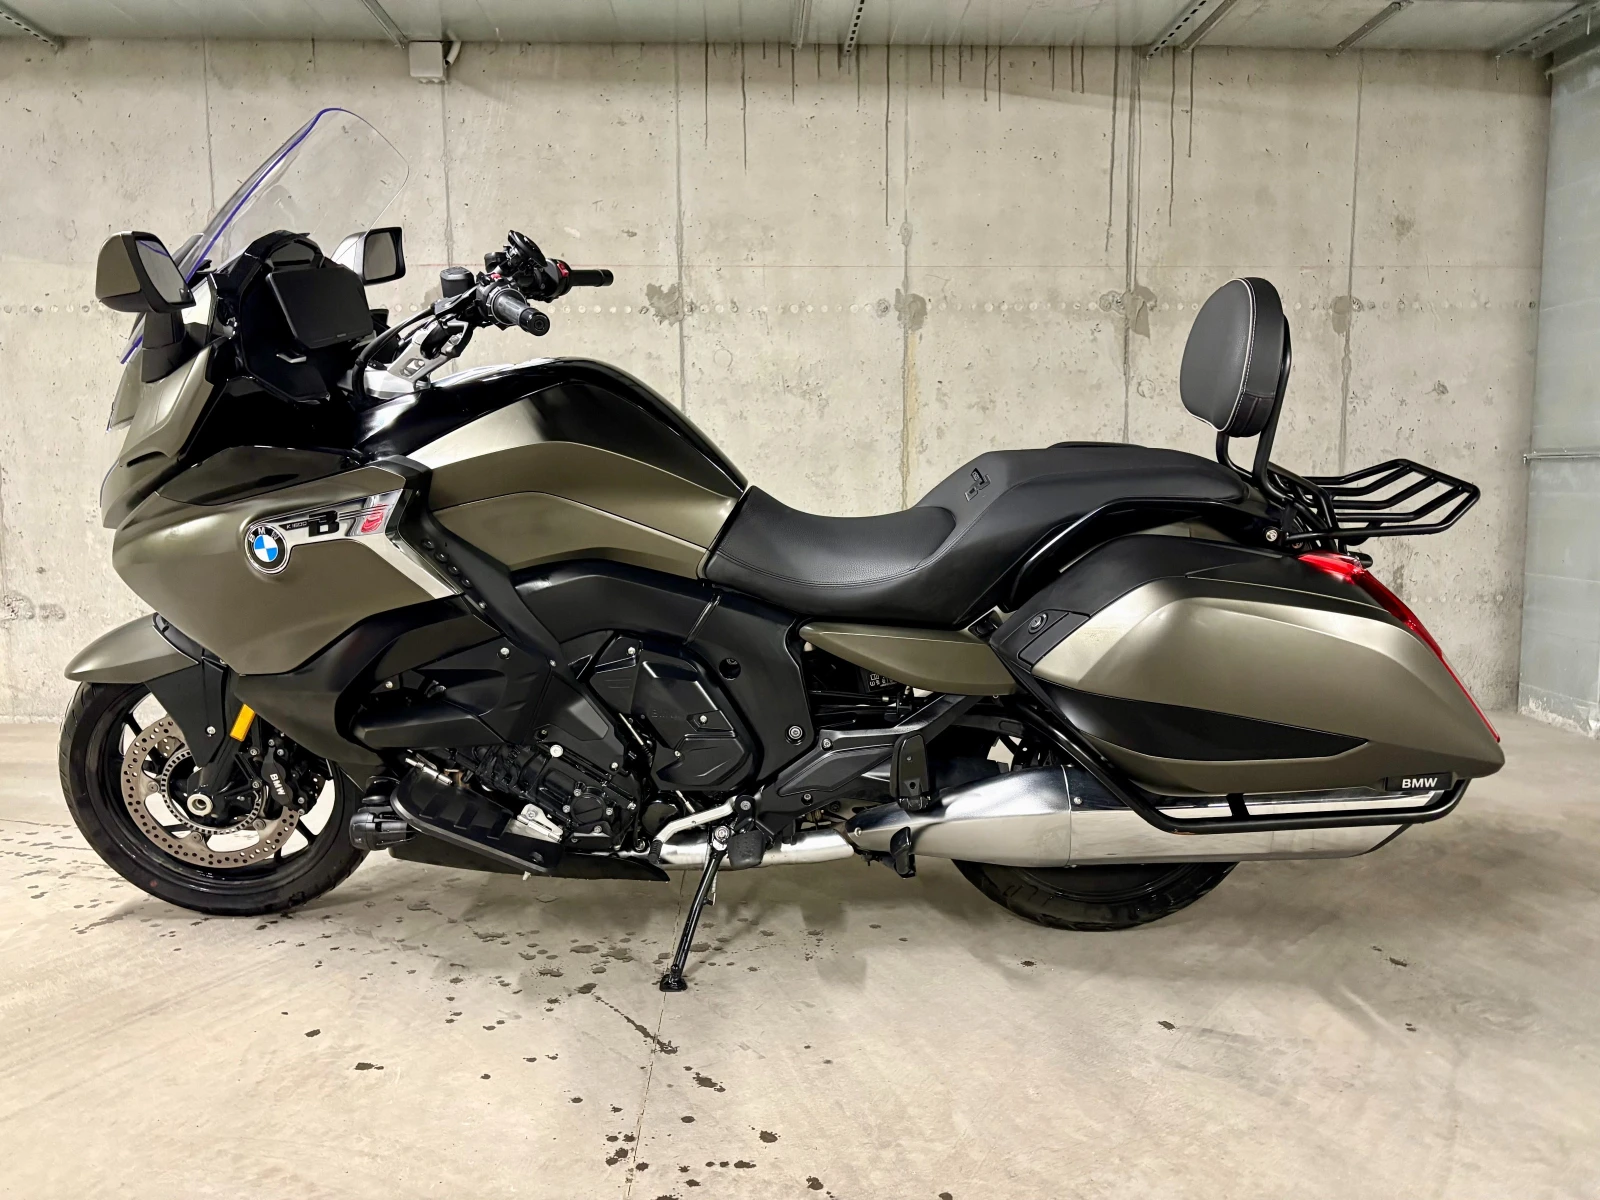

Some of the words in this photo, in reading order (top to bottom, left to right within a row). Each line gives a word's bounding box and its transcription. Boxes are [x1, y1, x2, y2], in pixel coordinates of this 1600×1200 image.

[308, 510, 340, 537] B
[248, 526, 280, 543] BMW
[269, 773, 285, 795] BMW
[1401, 777, 1438, 788] BMW
